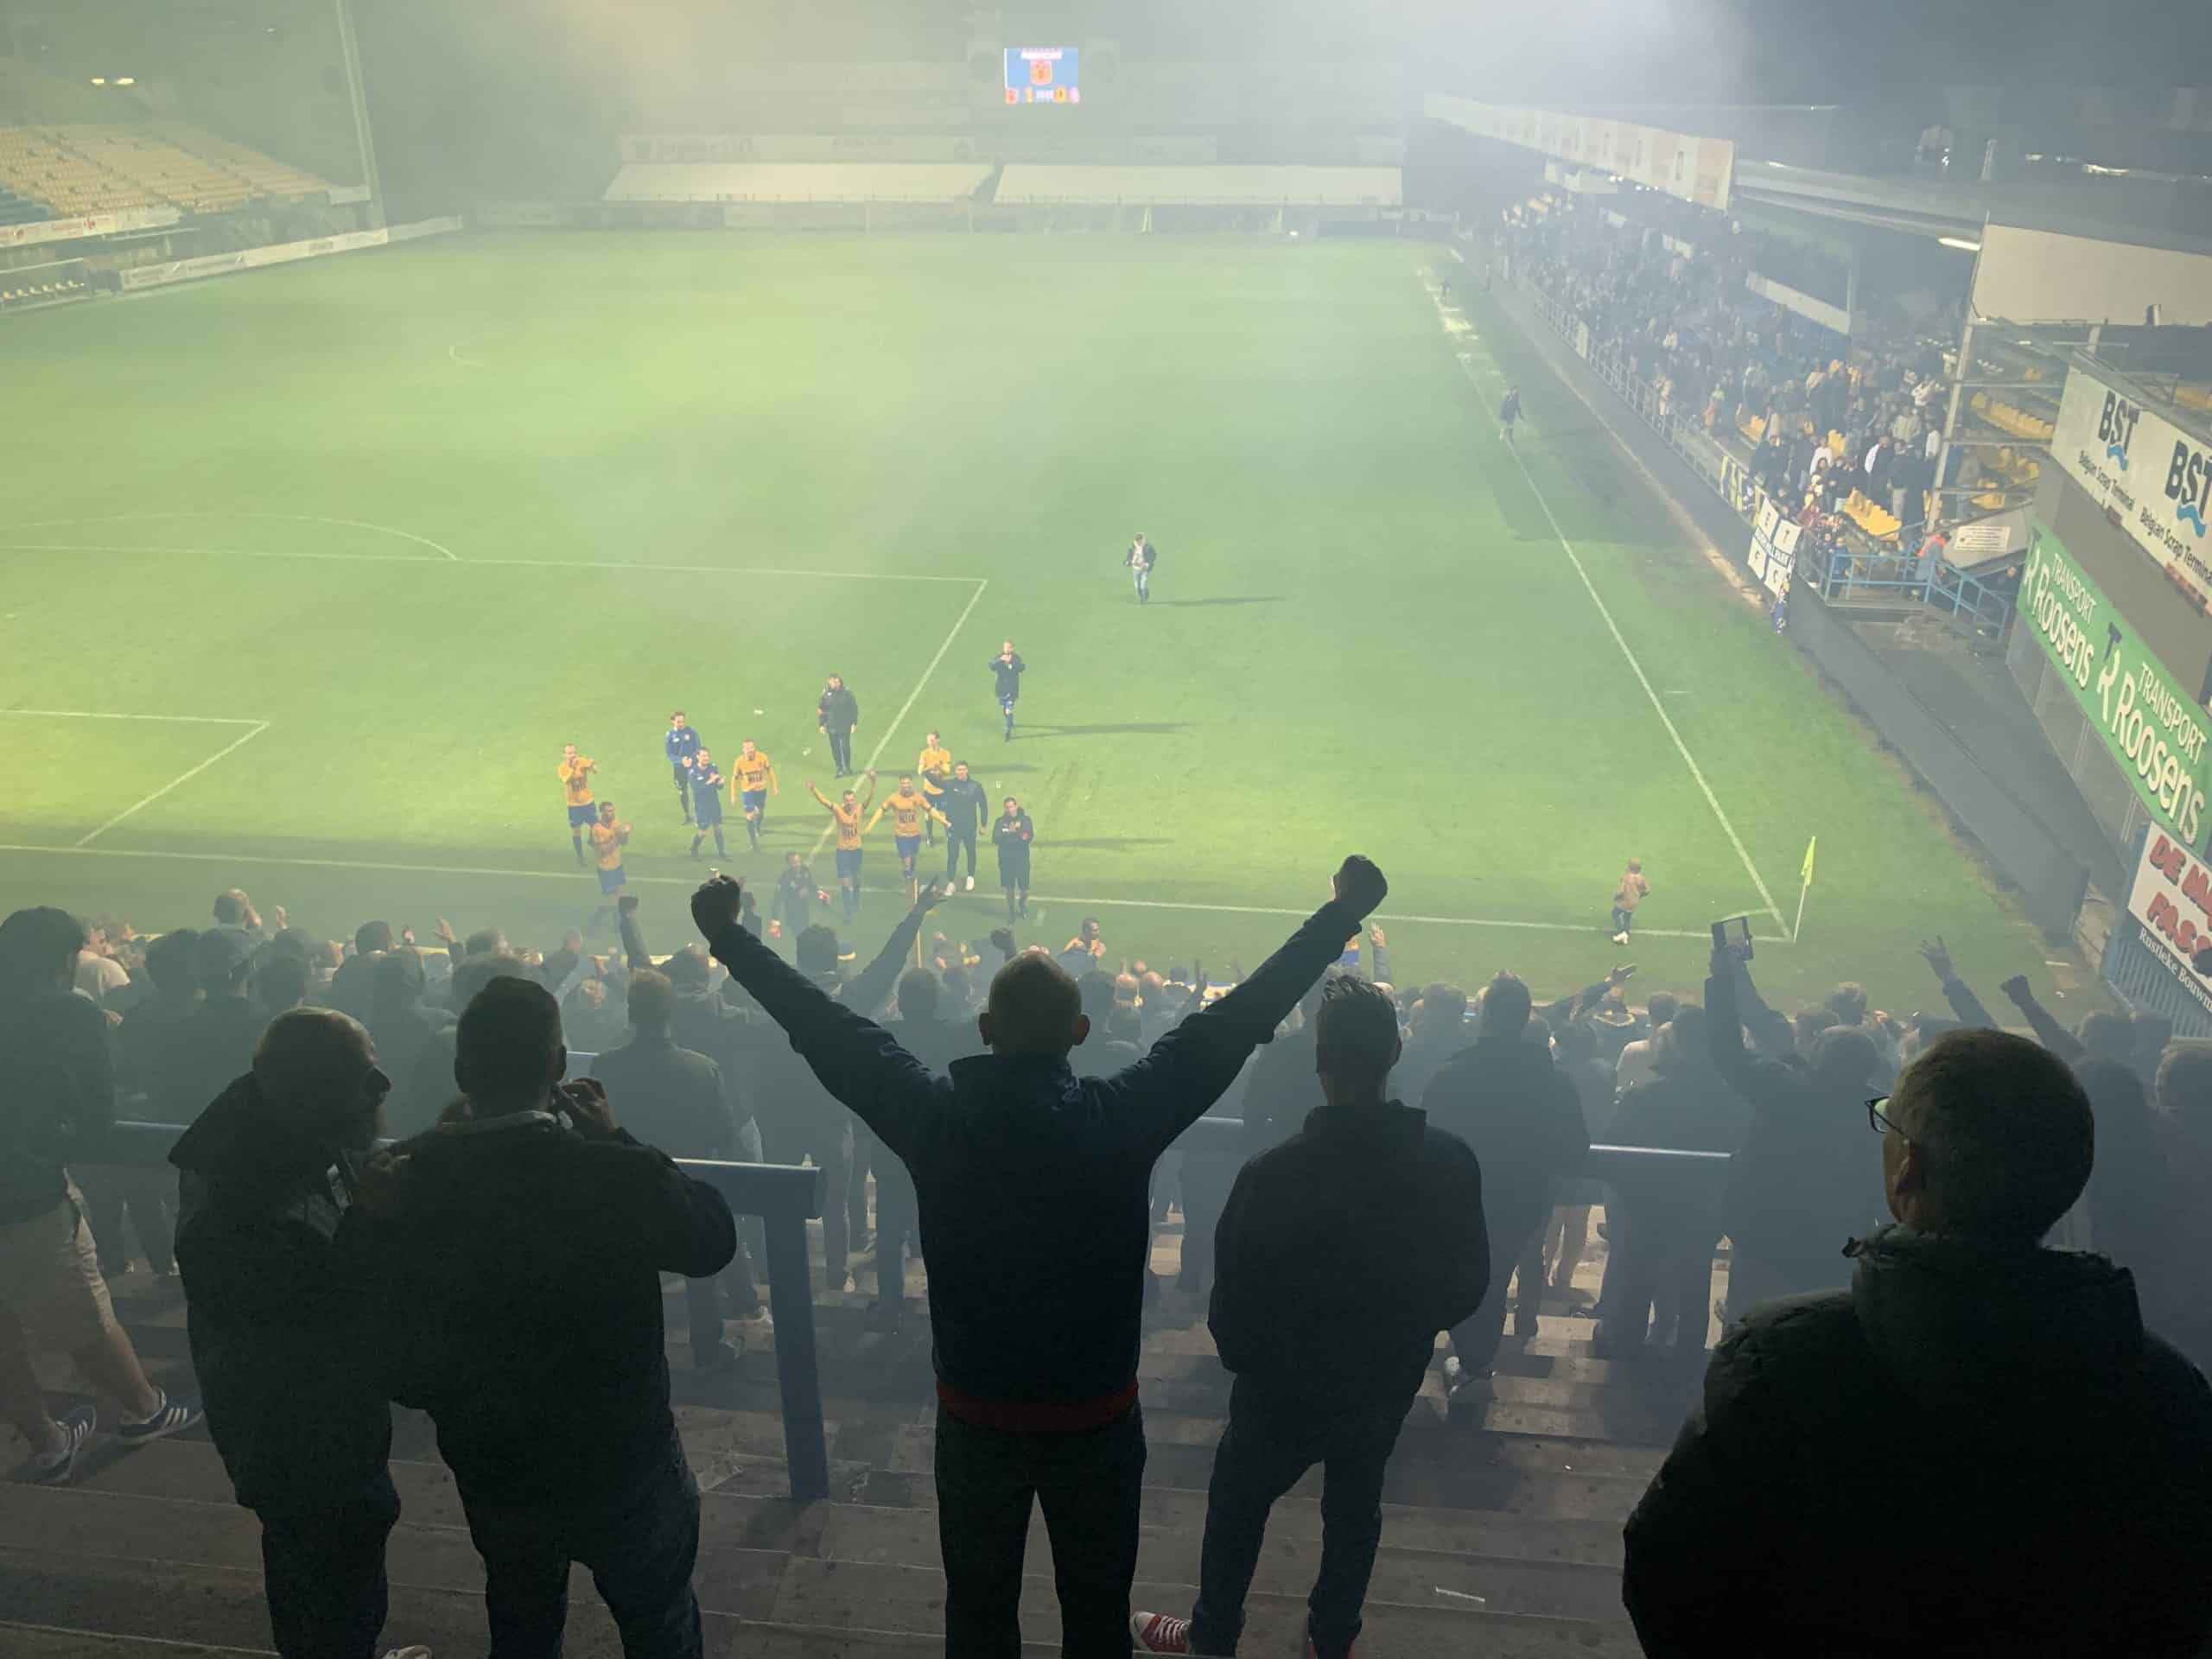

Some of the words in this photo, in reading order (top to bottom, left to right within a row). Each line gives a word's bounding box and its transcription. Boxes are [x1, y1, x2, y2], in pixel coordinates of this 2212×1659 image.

[2098, 390, 2140, 456] BST
[2164, 440, 2212, 520] BST
[2139, 505, 2164, 539] Belgian
[2164, 528, 2184, 562] Scrap
[2051, 552, 2097, 625] TRANSPORT
[2138, 661, 2207, 766] TRANSPORT
[2149, 834, 2187, 887] DE
[2139, 925, 2178, 976] Rustieke
